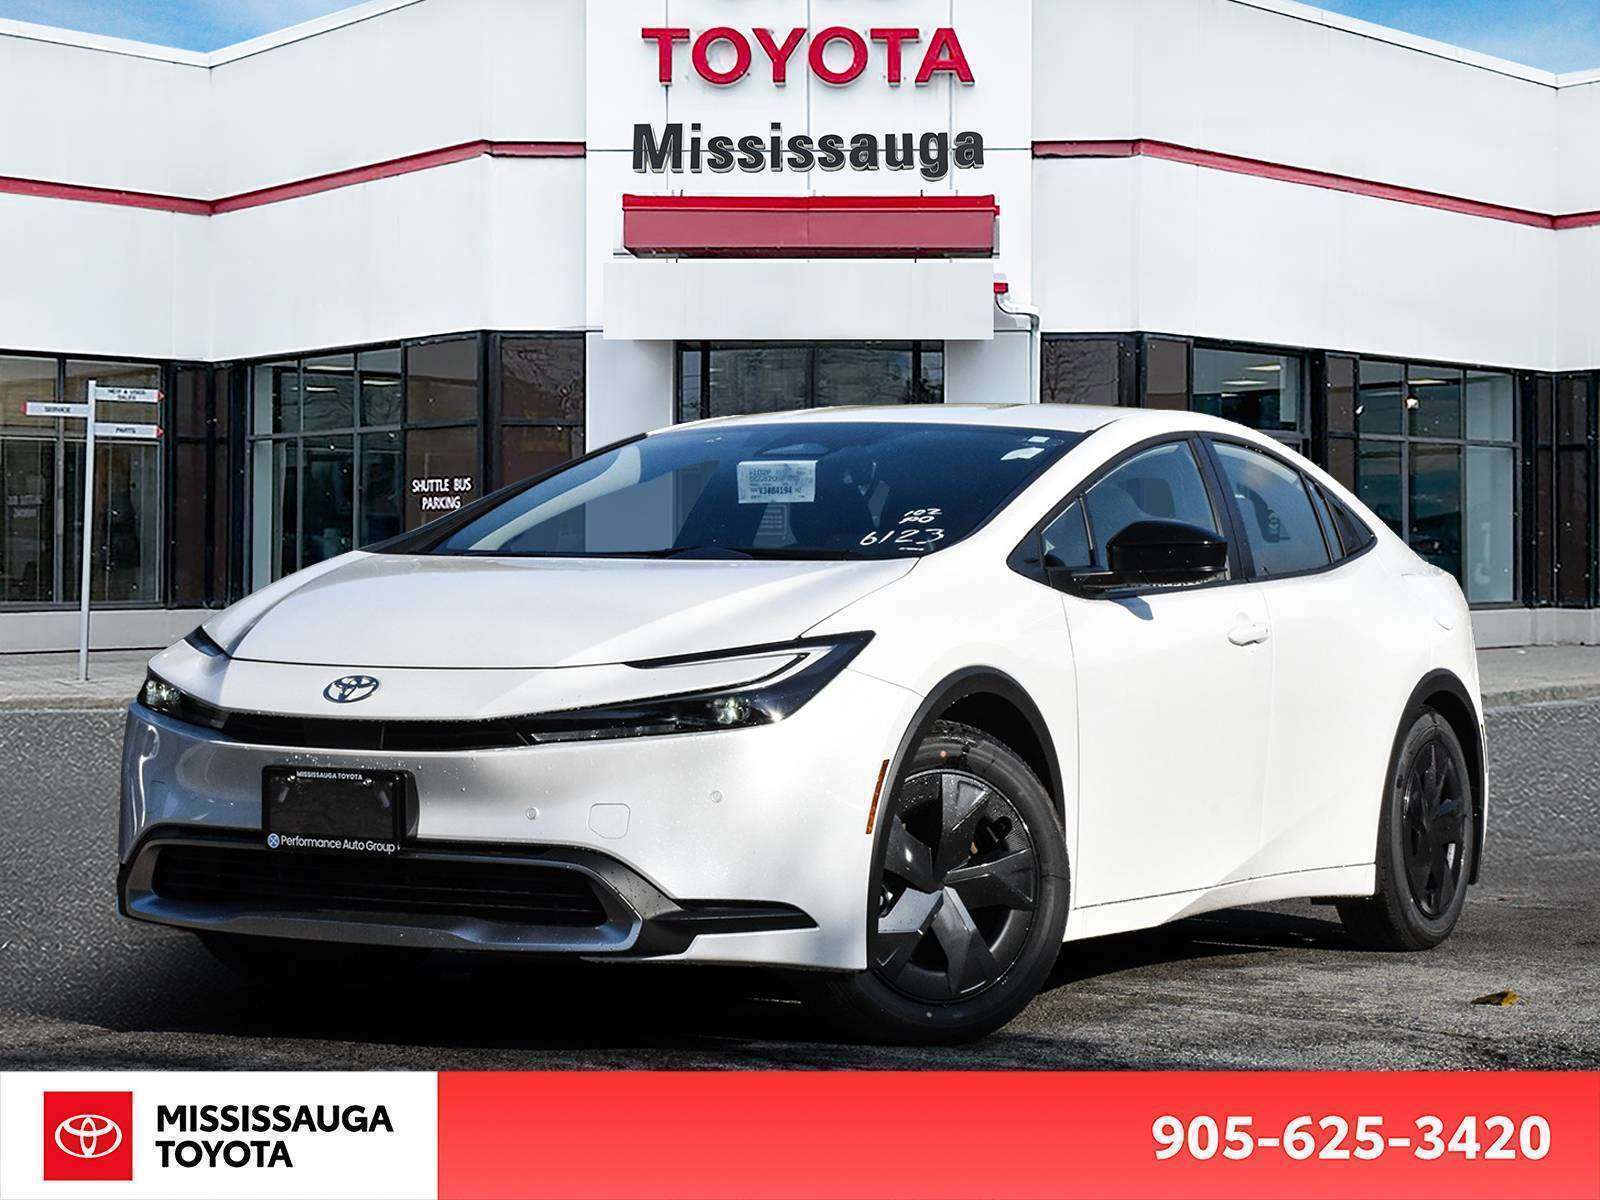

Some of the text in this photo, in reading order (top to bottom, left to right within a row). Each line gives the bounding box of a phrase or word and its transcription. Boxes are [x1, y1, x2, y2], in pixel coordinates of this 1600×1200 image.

[641, 26, 976, 87] TOYOTA
[632, 122, 985, 182] Mississauga
[411, 477, 472, 493] SHUTTLE BUS
[421, 495, 462, 511] PARKING
[859, 528, 945, 546] 6123
[296, 770, 363, 781] MISSISSAUGA TOYOTA
[280, 834, 396, 855] Performance Auto Group
